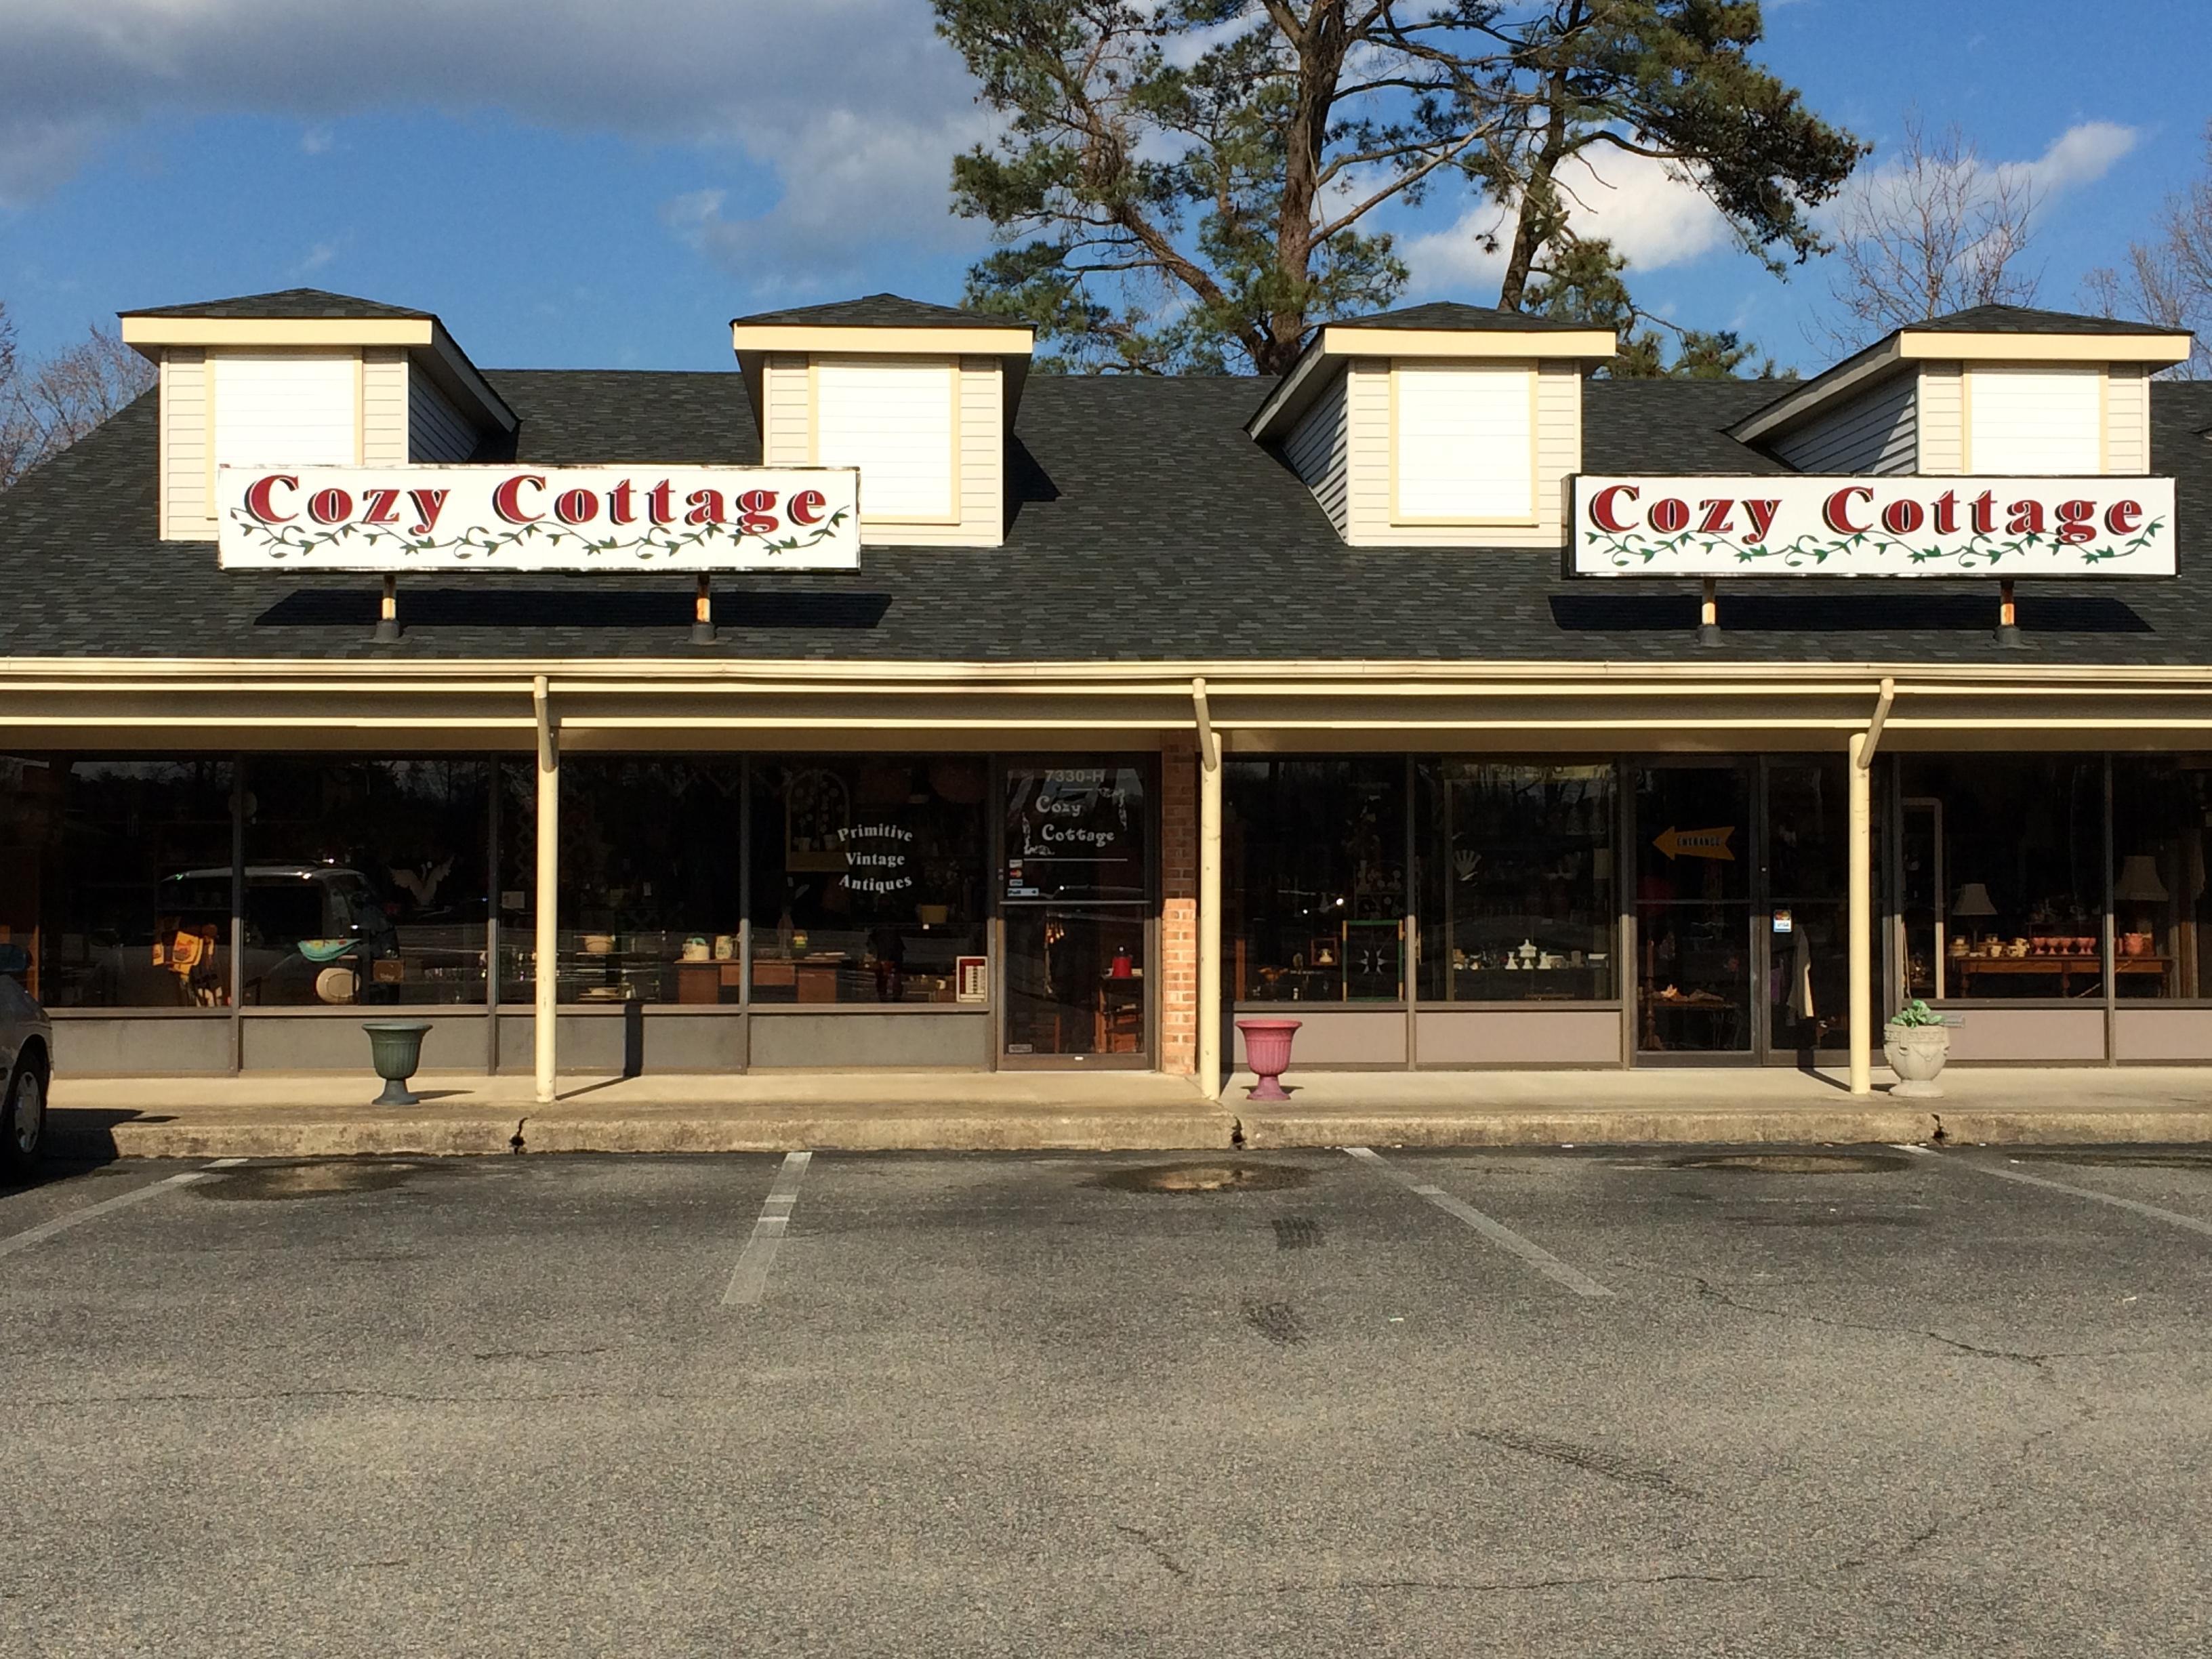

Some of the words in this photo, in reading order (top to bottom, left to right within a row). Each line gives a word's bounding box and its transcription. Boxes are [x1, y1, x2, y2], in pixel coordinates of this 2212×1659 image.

[244, 474, 451, 536] Cozy
[491, 474, 827, 536] Cottage
[1588, 485, 1783, 546] Cozy
[1822, 486, 2144, 546] Cottage
[1044, 769, 1106, 783] 7330-H
[1036, 796, 1082, 817] Cozy
[837, 823, 914, 842] Primitive
[1042, 823, 1115, 848] Cottage
[845, 852, 905, 868] Vintage
[838, 874, 913, 894] Antiques
